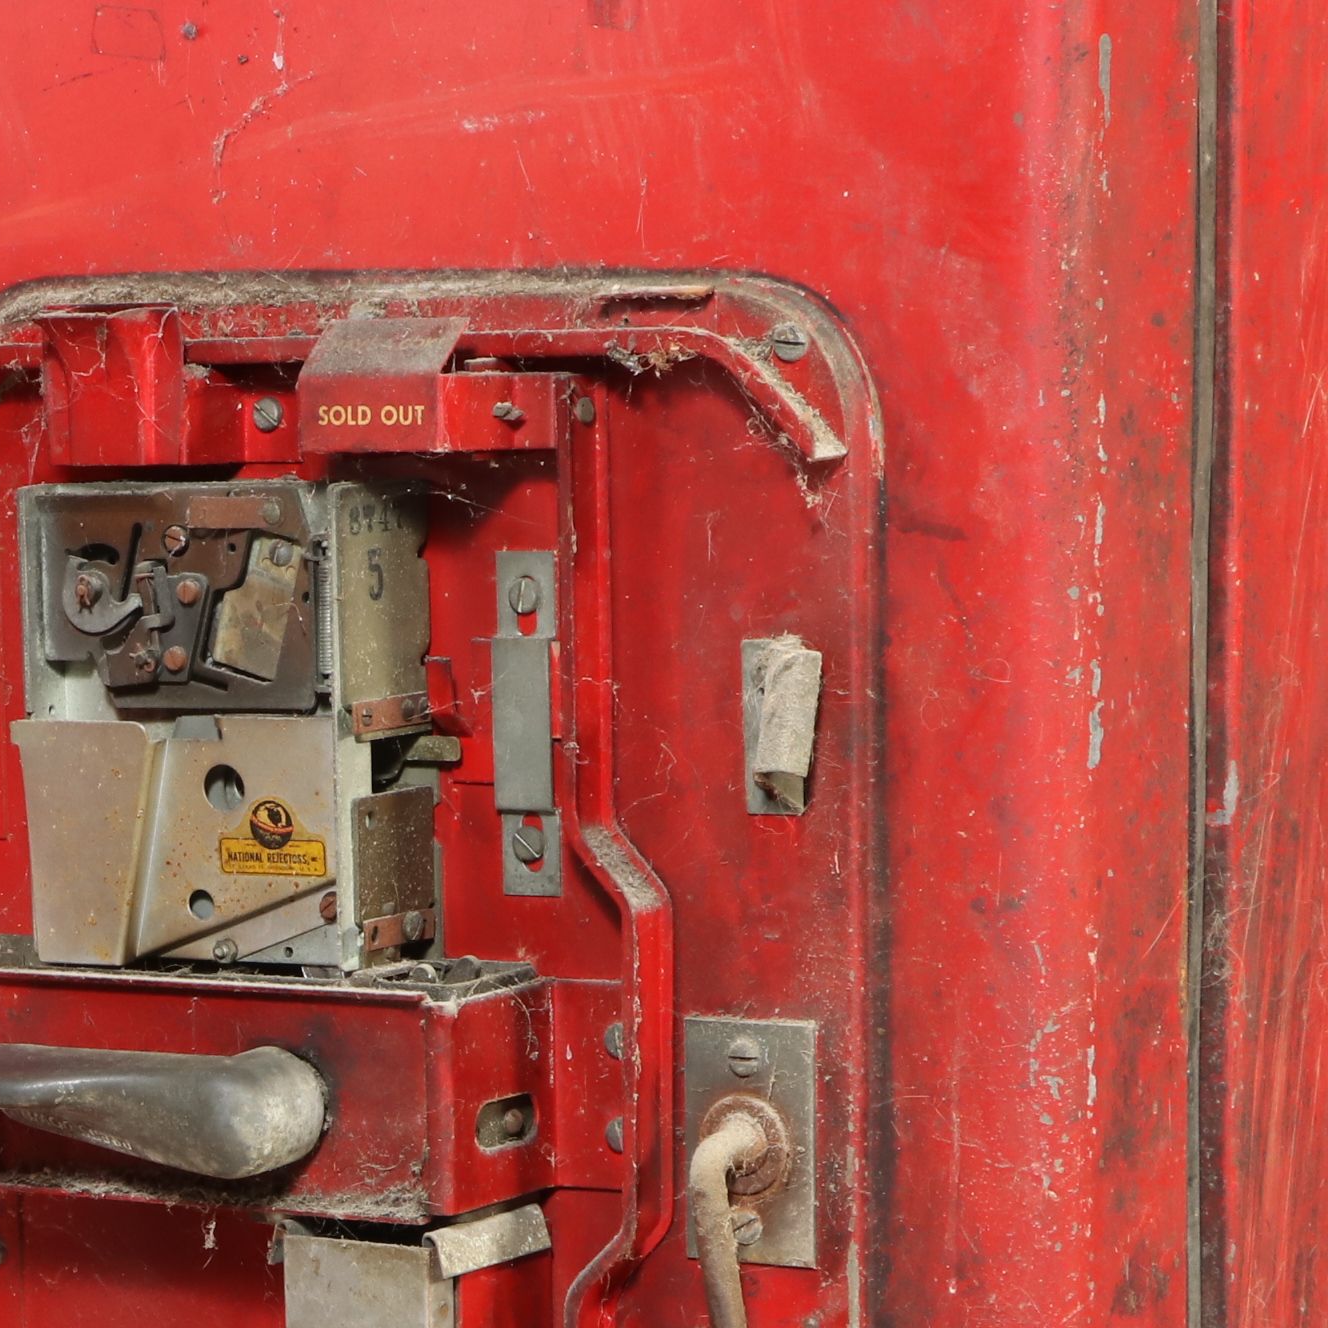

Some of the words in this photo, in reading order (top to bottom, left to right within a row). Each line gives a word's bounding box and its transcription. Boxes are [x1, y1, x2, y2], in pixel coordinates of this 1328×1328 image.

[318, 405, 372, 426] SOLD
[380, 405, 425, 426] OUT
[368, 547, 384, 601] 5
[227, 851, 263, 863] NATIONAL
